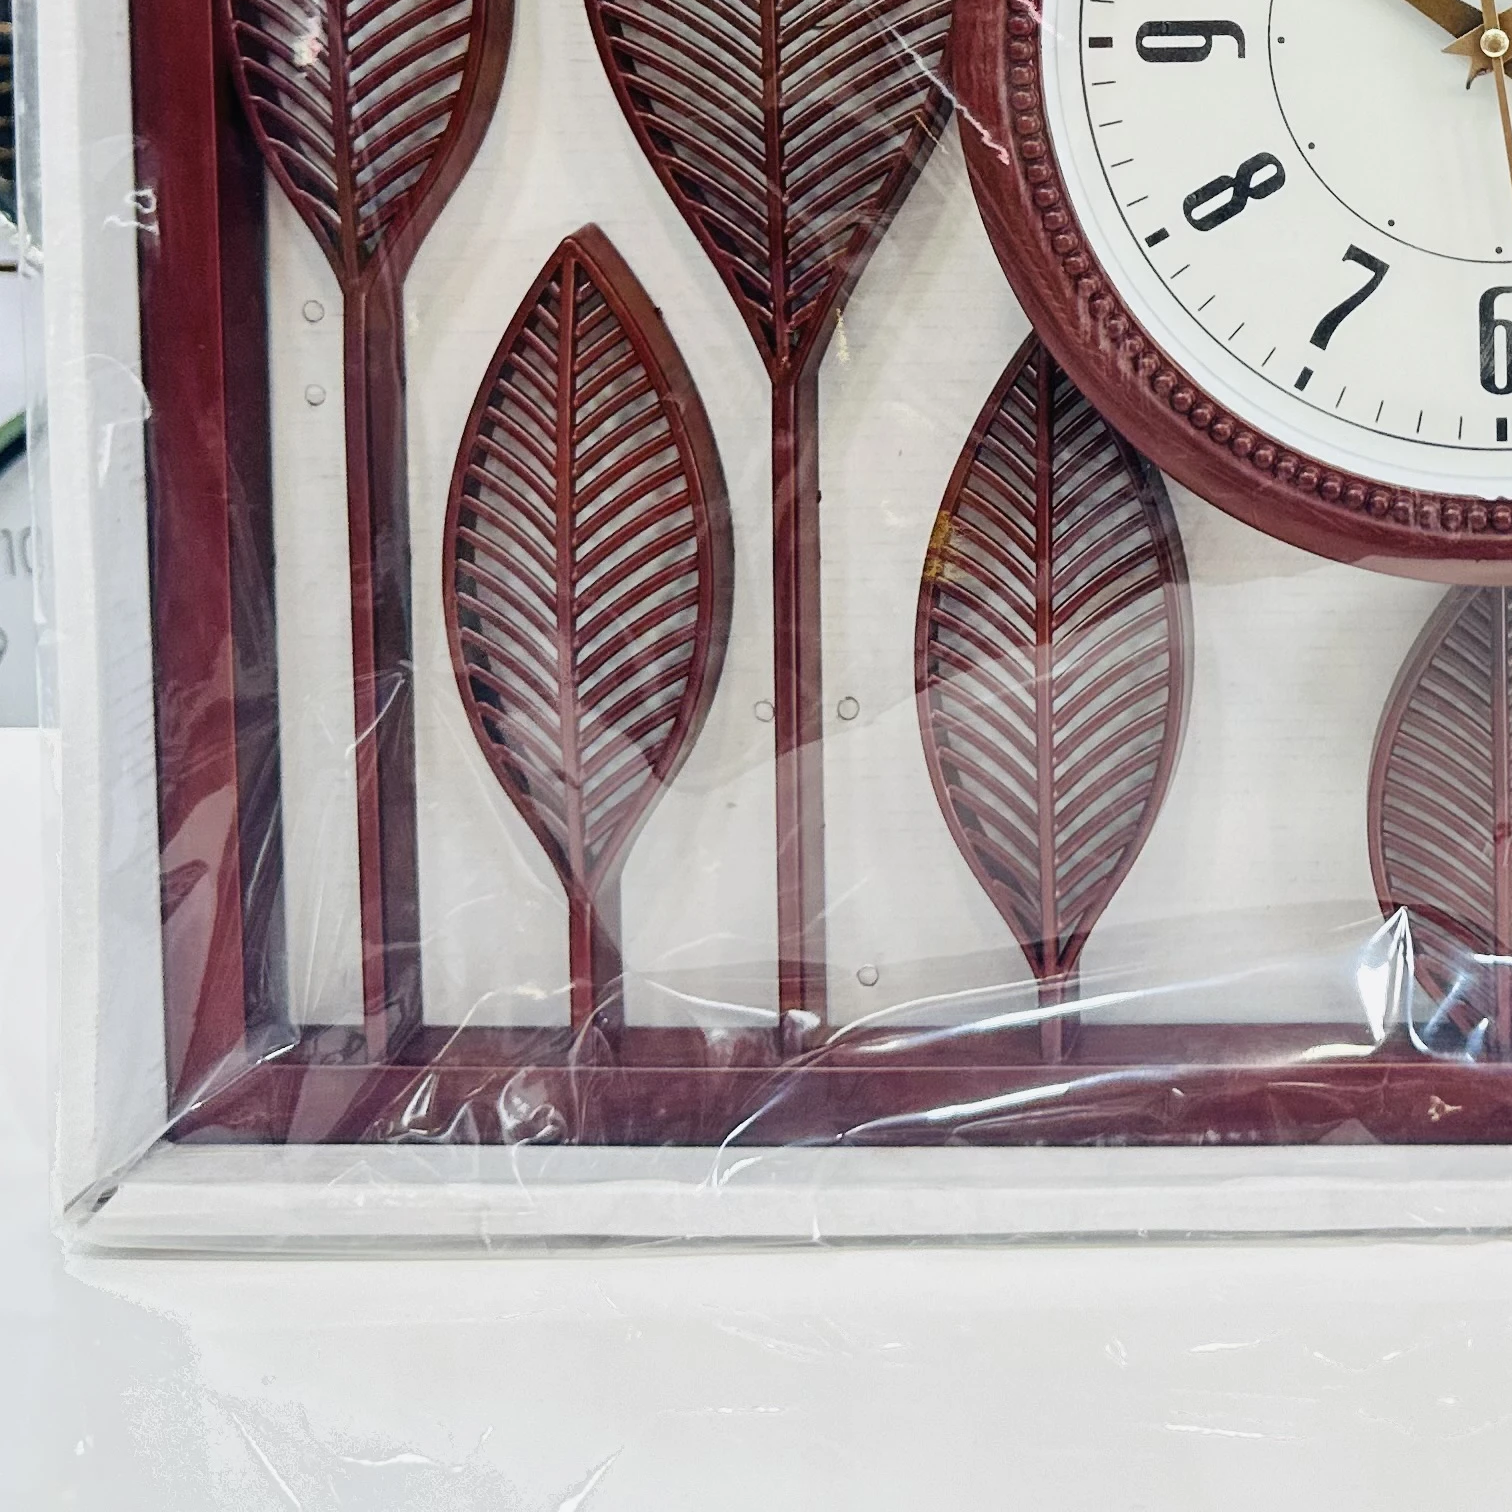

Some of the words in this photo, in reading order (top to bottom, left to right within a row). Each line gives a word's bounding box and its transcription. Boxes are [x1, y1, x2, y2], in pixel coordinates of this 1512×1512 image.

[1135, 19, 1246, 64] 9
[1182, 151, 1286, 233] 8
[1310, 243, 1390, 351] 7
